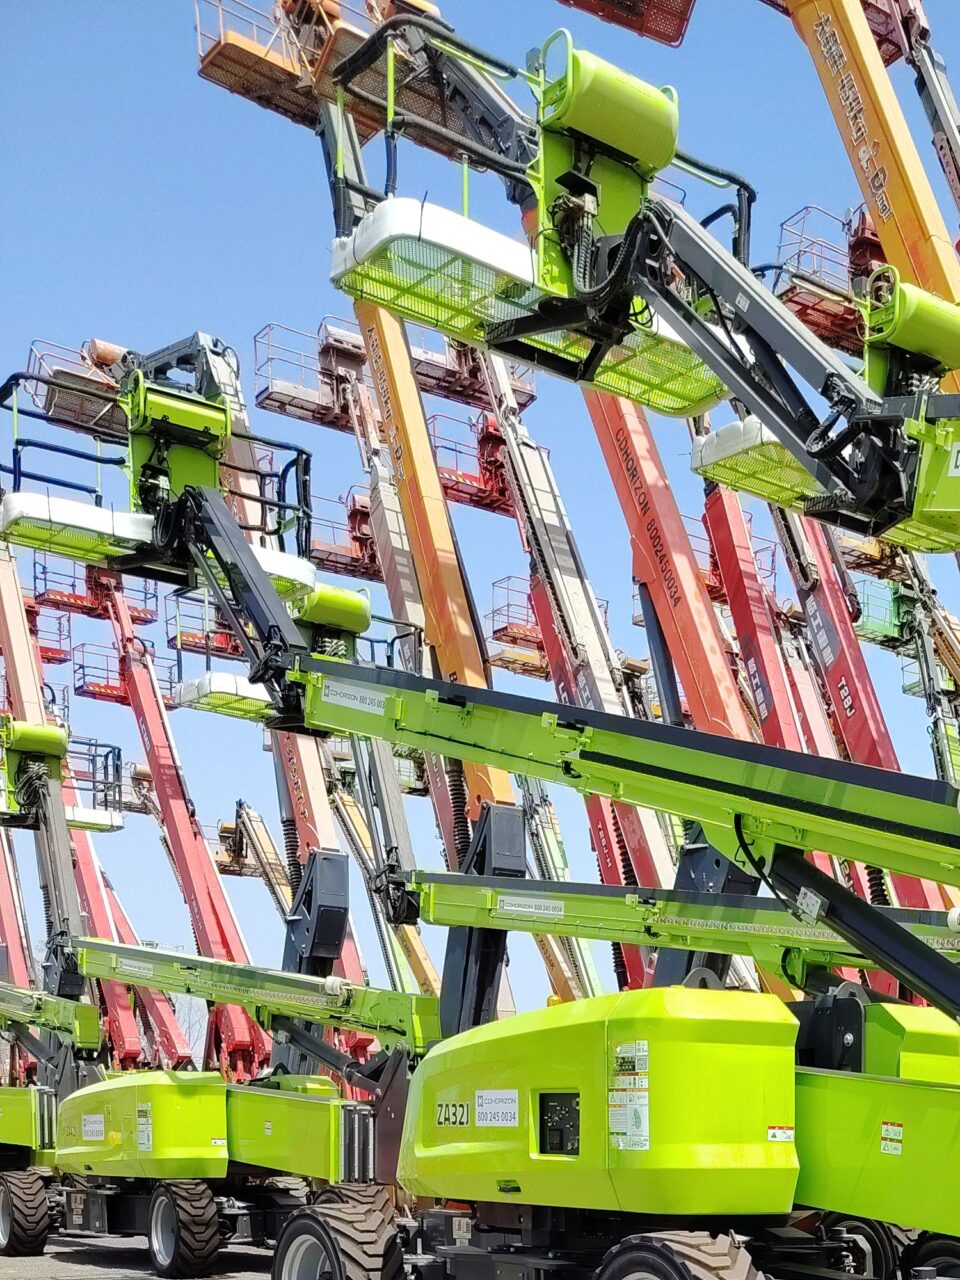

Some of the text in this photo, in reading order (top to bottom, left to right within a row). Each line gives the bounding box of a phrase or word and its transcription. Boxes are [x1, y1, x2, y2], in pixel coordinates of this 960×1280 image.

[615, 428, 682, 608] CDHORIZON 8002450034
[837, 676, 856, 717] T28J
[437, 1102, 469, 1126] ZA32J
[477, 1111, 516, 1122] 800 245 0034
